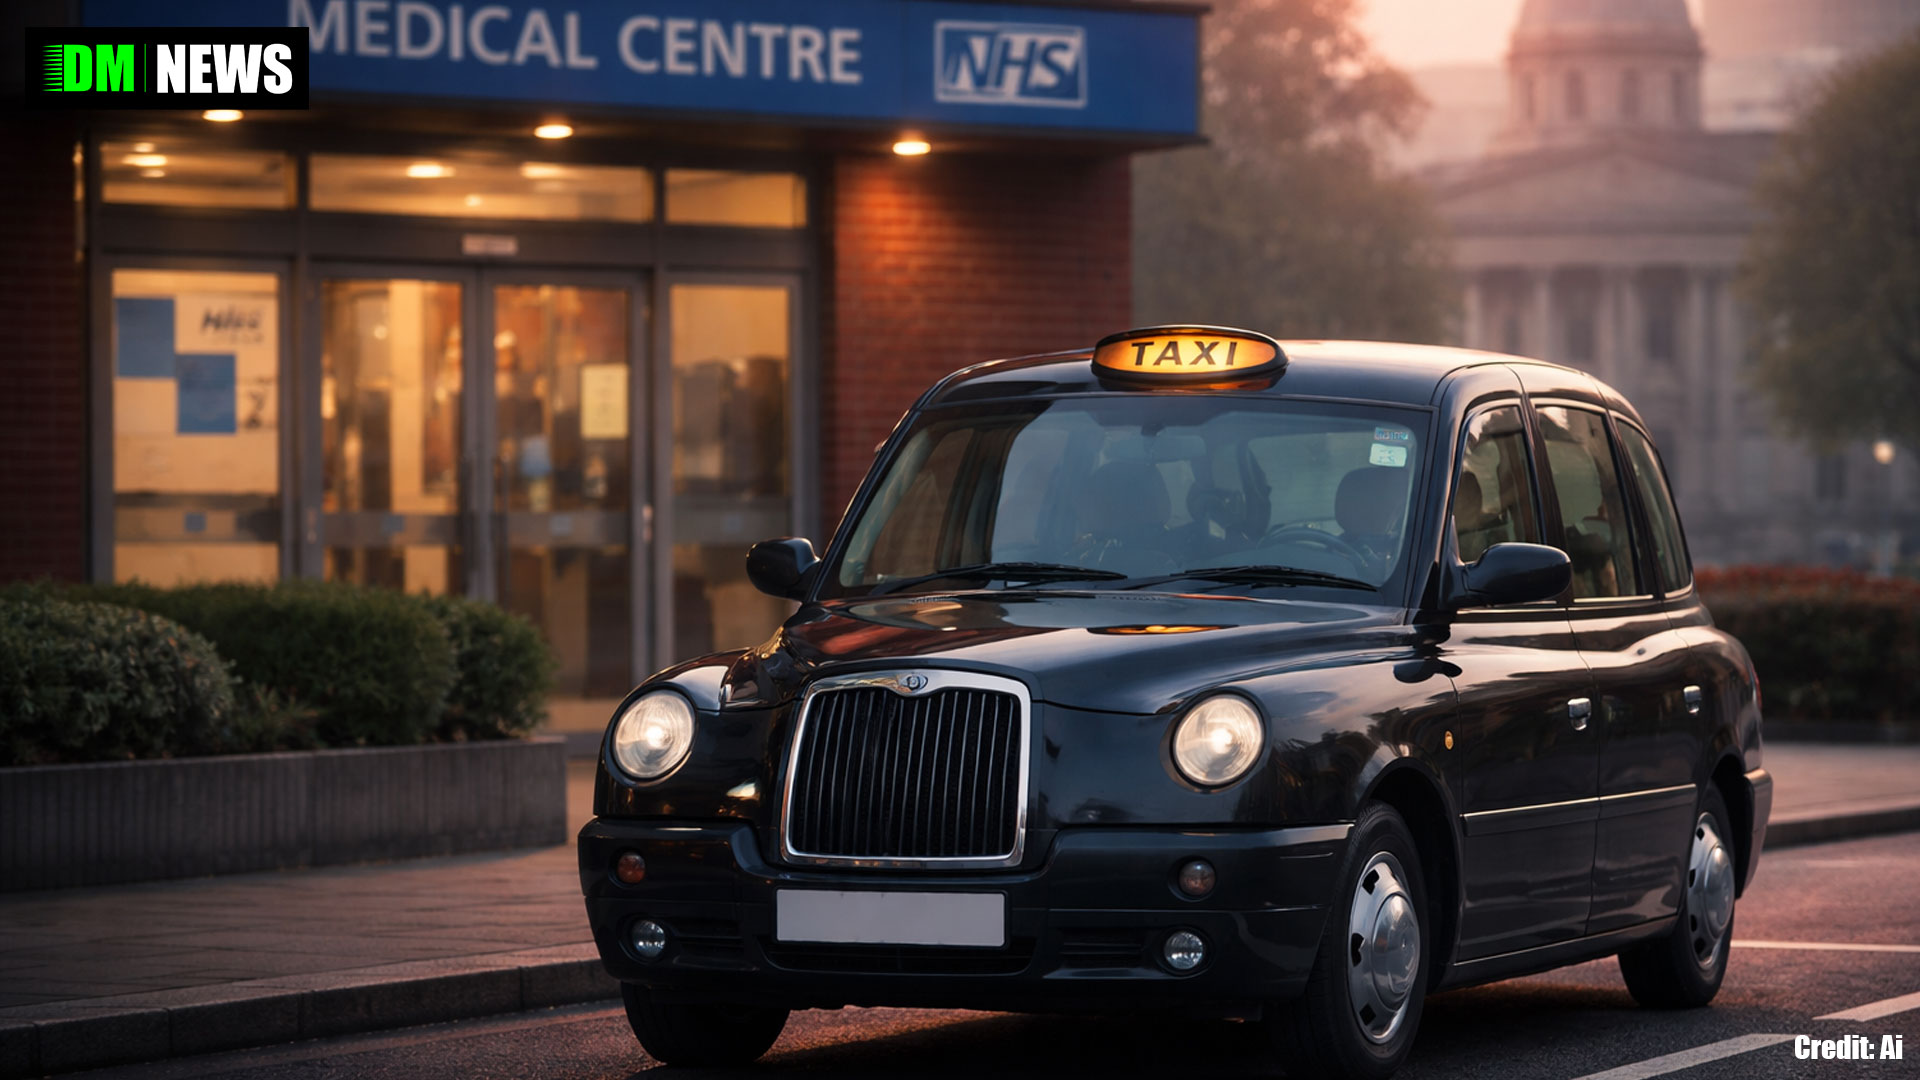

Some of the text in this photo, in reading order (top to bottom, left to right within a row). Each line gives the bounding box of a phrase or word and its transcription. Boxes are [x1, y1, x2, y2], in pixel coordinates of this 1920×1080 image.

[288, 0, 863, 85] MEDICAL CENTRE
[945, 33, 1078, 98] NHS
[1131, 341, 1238, 366] TAXI
